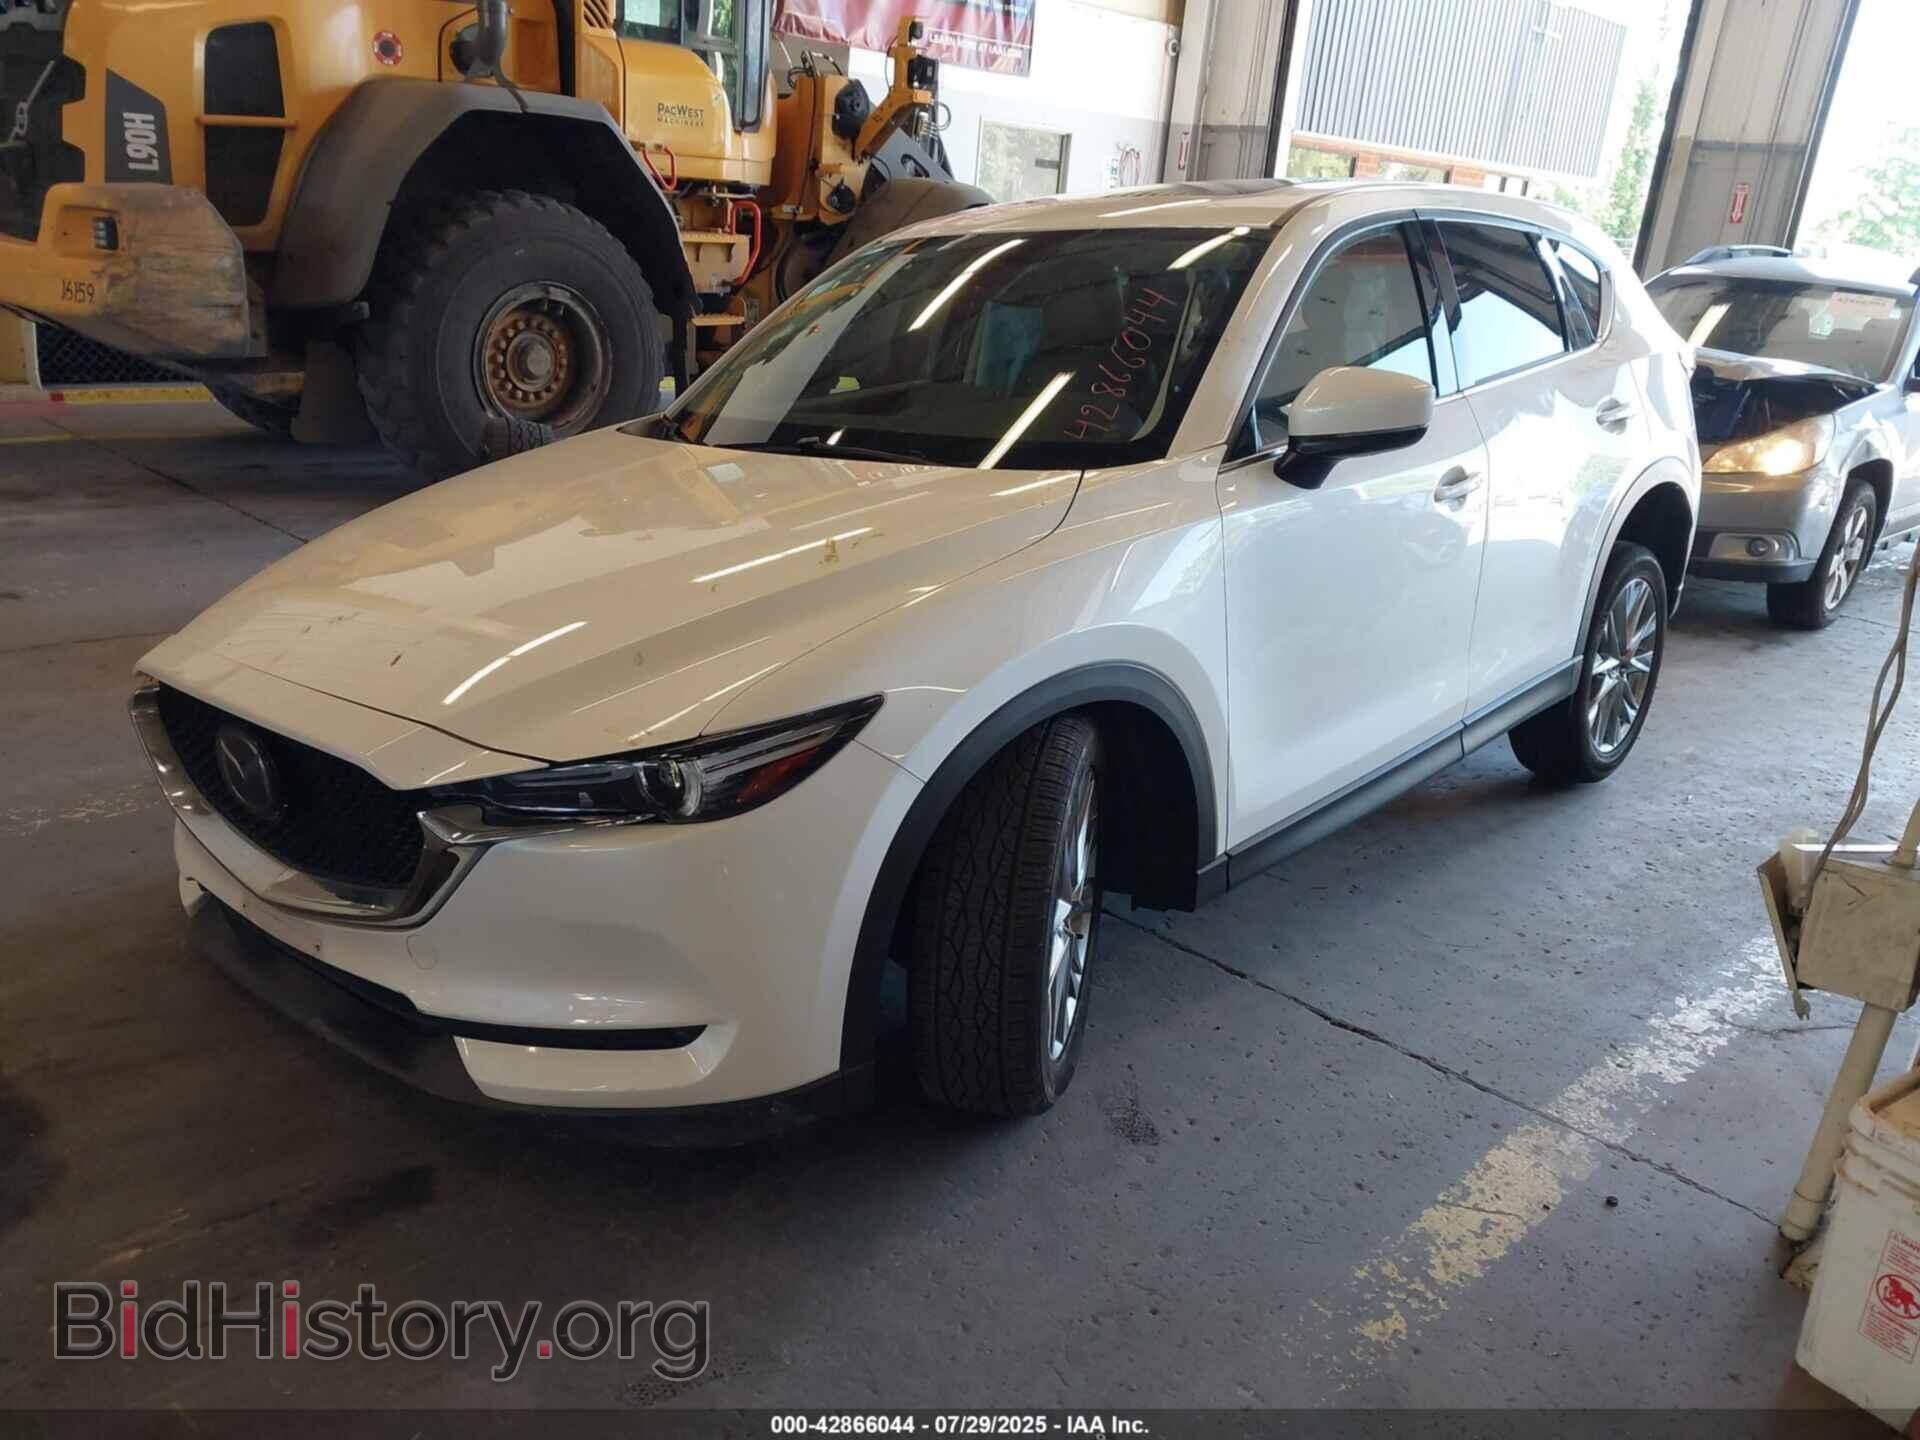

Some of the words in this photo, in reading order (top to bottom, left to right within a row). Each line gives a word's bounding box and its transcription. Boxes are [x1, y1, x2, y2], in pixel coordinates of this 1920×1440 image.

[122, 111, 159, 171] L90H
[61, 279, 96, 304] 16159
[1063, 287, 1178, 440] 42866044
